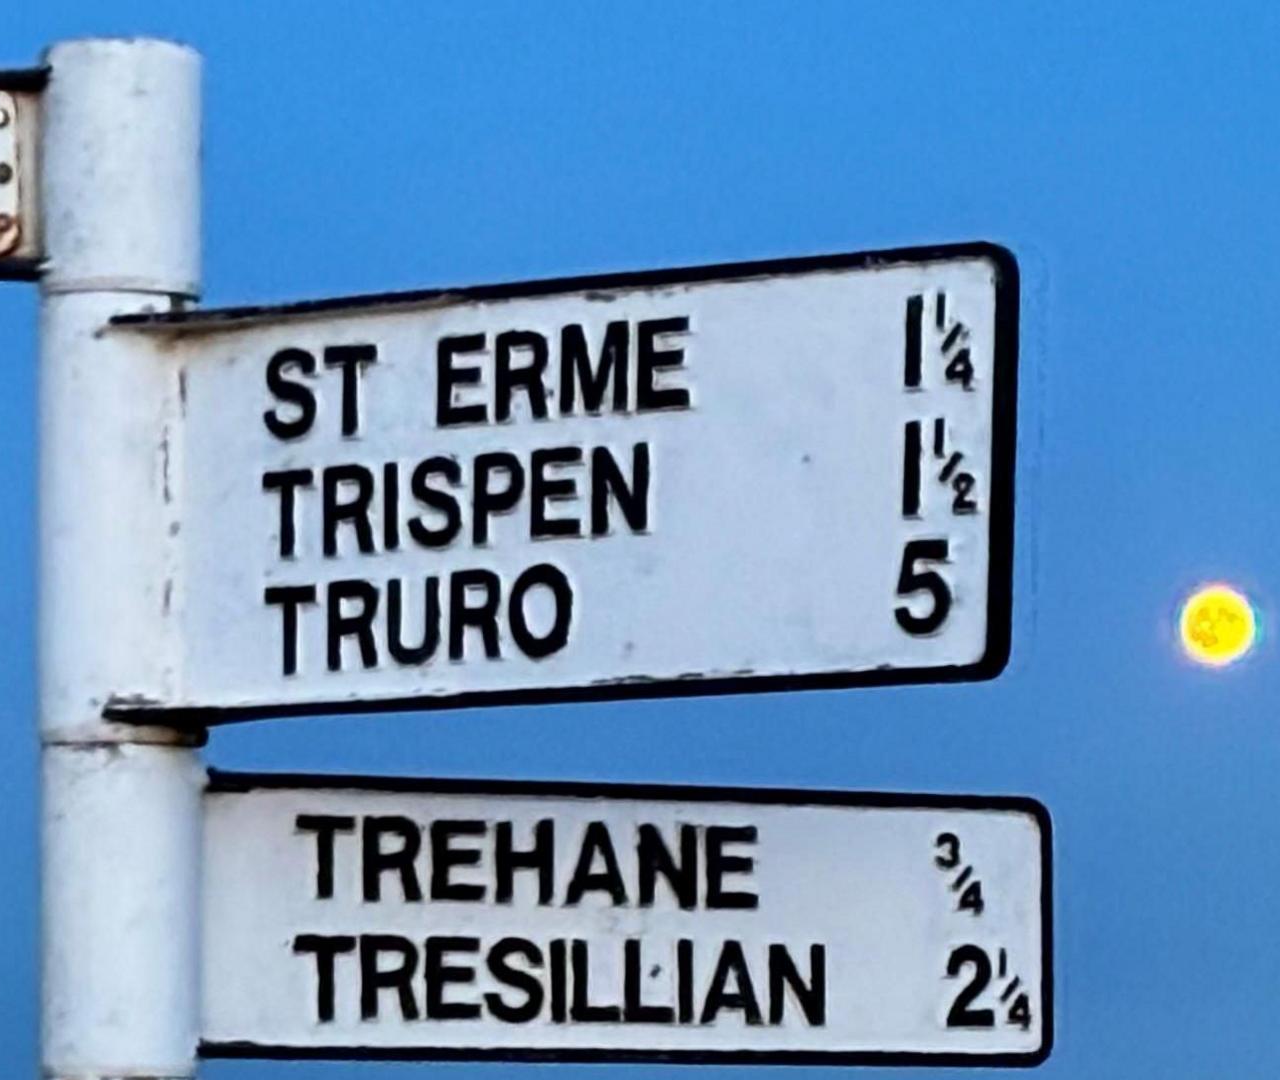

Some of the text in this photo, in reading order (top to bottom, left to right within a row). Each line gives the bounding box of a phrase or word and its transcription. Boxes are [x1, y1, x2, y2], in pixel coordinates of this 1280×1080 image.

[262, 343, 379, 442] ST
[435, 315, 691, 429] ERME
[262, 442, 650, 560] TRISPEN
[264, 538, 954, 677] TRURO 5
[294, 813, 760, 912] TREHANE
[293, 933, 827, 1027] TRESILLIAN
